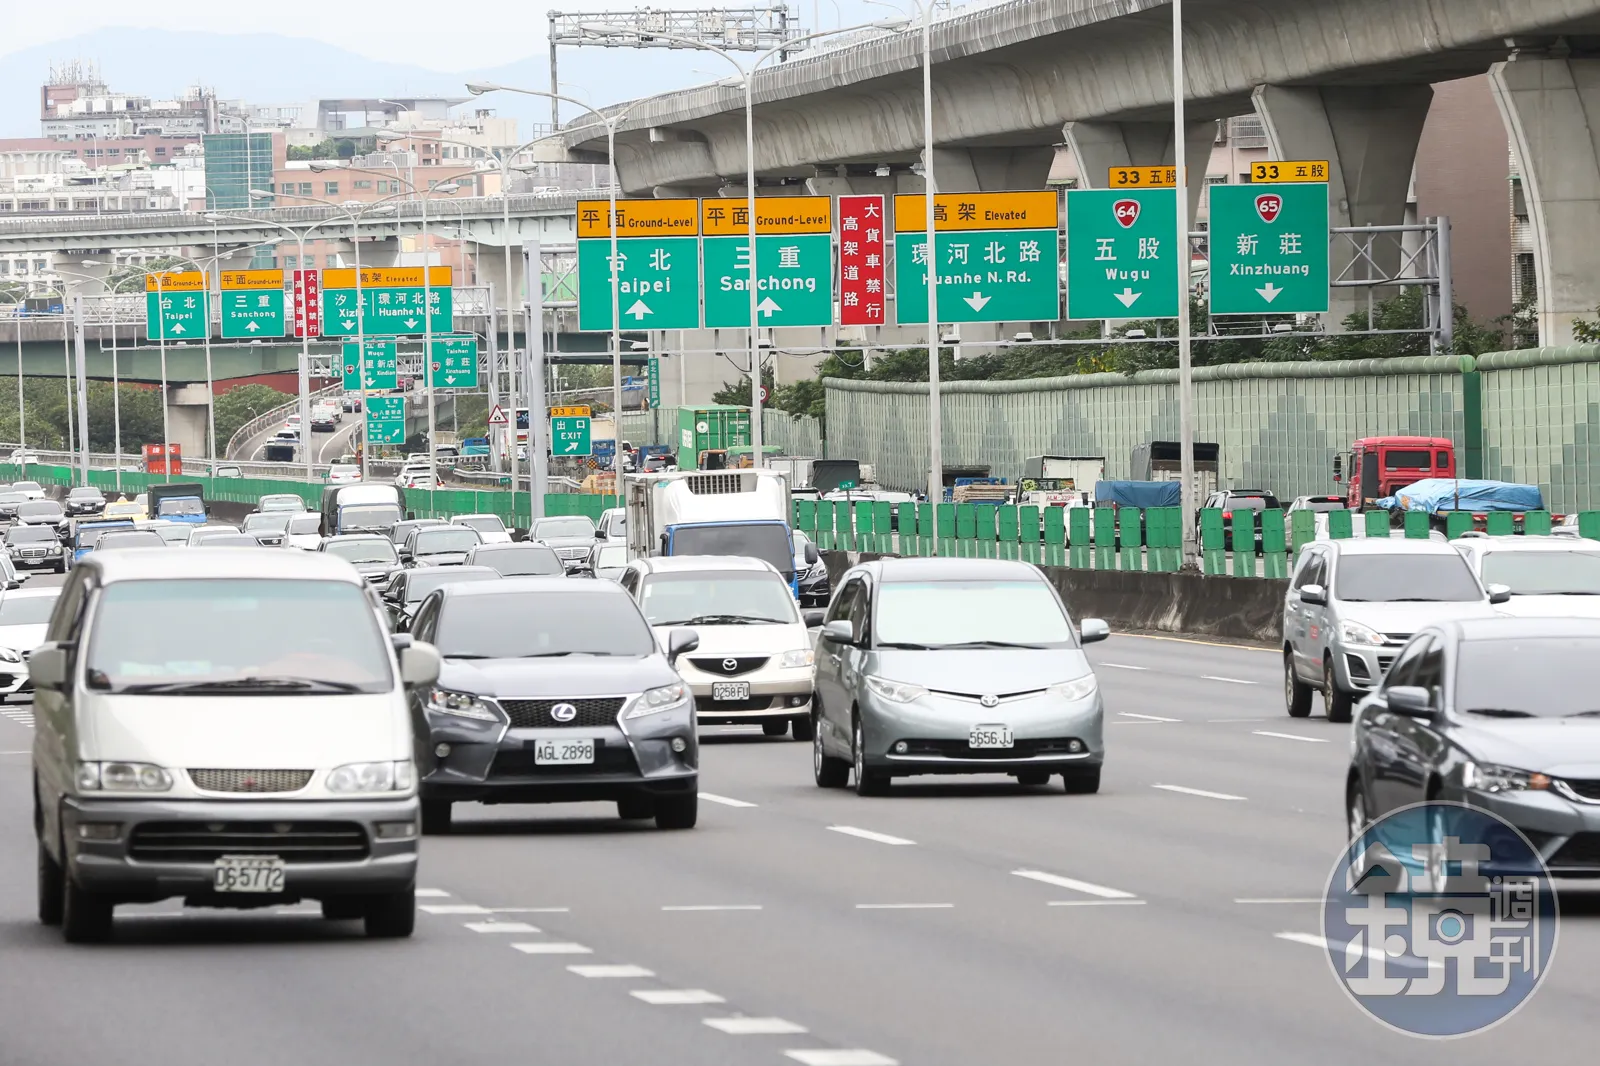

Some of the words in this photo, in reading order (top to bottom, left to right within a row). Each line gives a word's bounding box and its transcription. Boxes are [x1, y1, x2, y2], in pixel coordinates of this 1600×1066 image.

[1117, 171, 1140, 184] 33
[1149, 169, 1177, 184] 五股
[1256, 165, 1279, 179] 33
[1295, 164, 1324, 178] 五股
[933, 202, 976, 222] 高架
[984, 210, 1026, 221] Elevated
[1116, 205, 1135, 218] 64
[1259, 200, 1278, 213] 65
[581, 209, 625, 229] 平面
[628, 217, 693, 228] Ground-Level
[706, 207, 749, 226] 平面
[756, 215, 827, 225] Ground-Level
[1094, 237, 1160, 261] 五股
[1236, 232, 1302, 256] 新莊
[733, 245, 801, 269] 三重
[911, 239, 1042, 265] 環河北路
[605, 248, 672, 272] 台北
[842, 216, 859, 306] 高架道路
[864, 203, 882, 318] 大貨車禁行
[987, 271, 1003, 283] N.
[1007, 270, 1031, 283] Rd.
[1105, 268, 1150, 282] Wugu
[1229, 263, 1310, 277] Xinzhuang
[223, 274, 246, 285] 平面
[161, 296, 196, 310] 台北
[235, 294, 270, 307] 三重
[165, 312, 193, 321] Taipei
[230, 311, 276, 319] Sanchong
[378, 307, 414, 316] Huanhe
[553, 408, 565, 416] 33
[556, 420, 586, 431] 出口
[560, 431, 582, 440] EXIT
